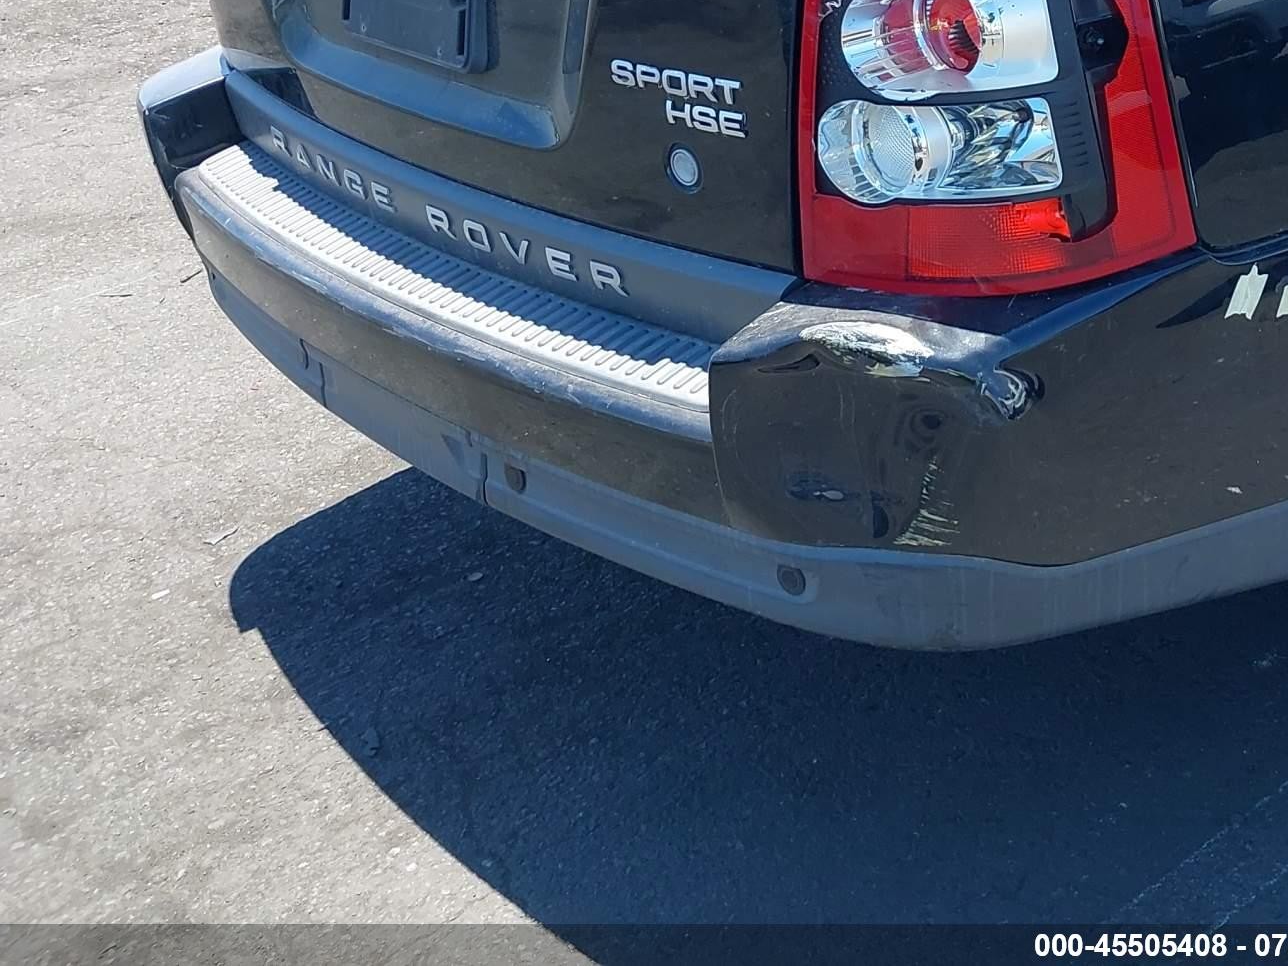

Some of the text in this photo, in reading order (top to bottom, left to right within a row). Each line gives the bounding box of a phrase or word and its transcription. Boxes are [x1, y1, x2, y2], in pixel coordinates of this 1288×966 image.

[610, 59, 742, 105] SPORT
[665, 99, 747, 138] HSE
[270, 125, 629, 298] RANGE ROVER
